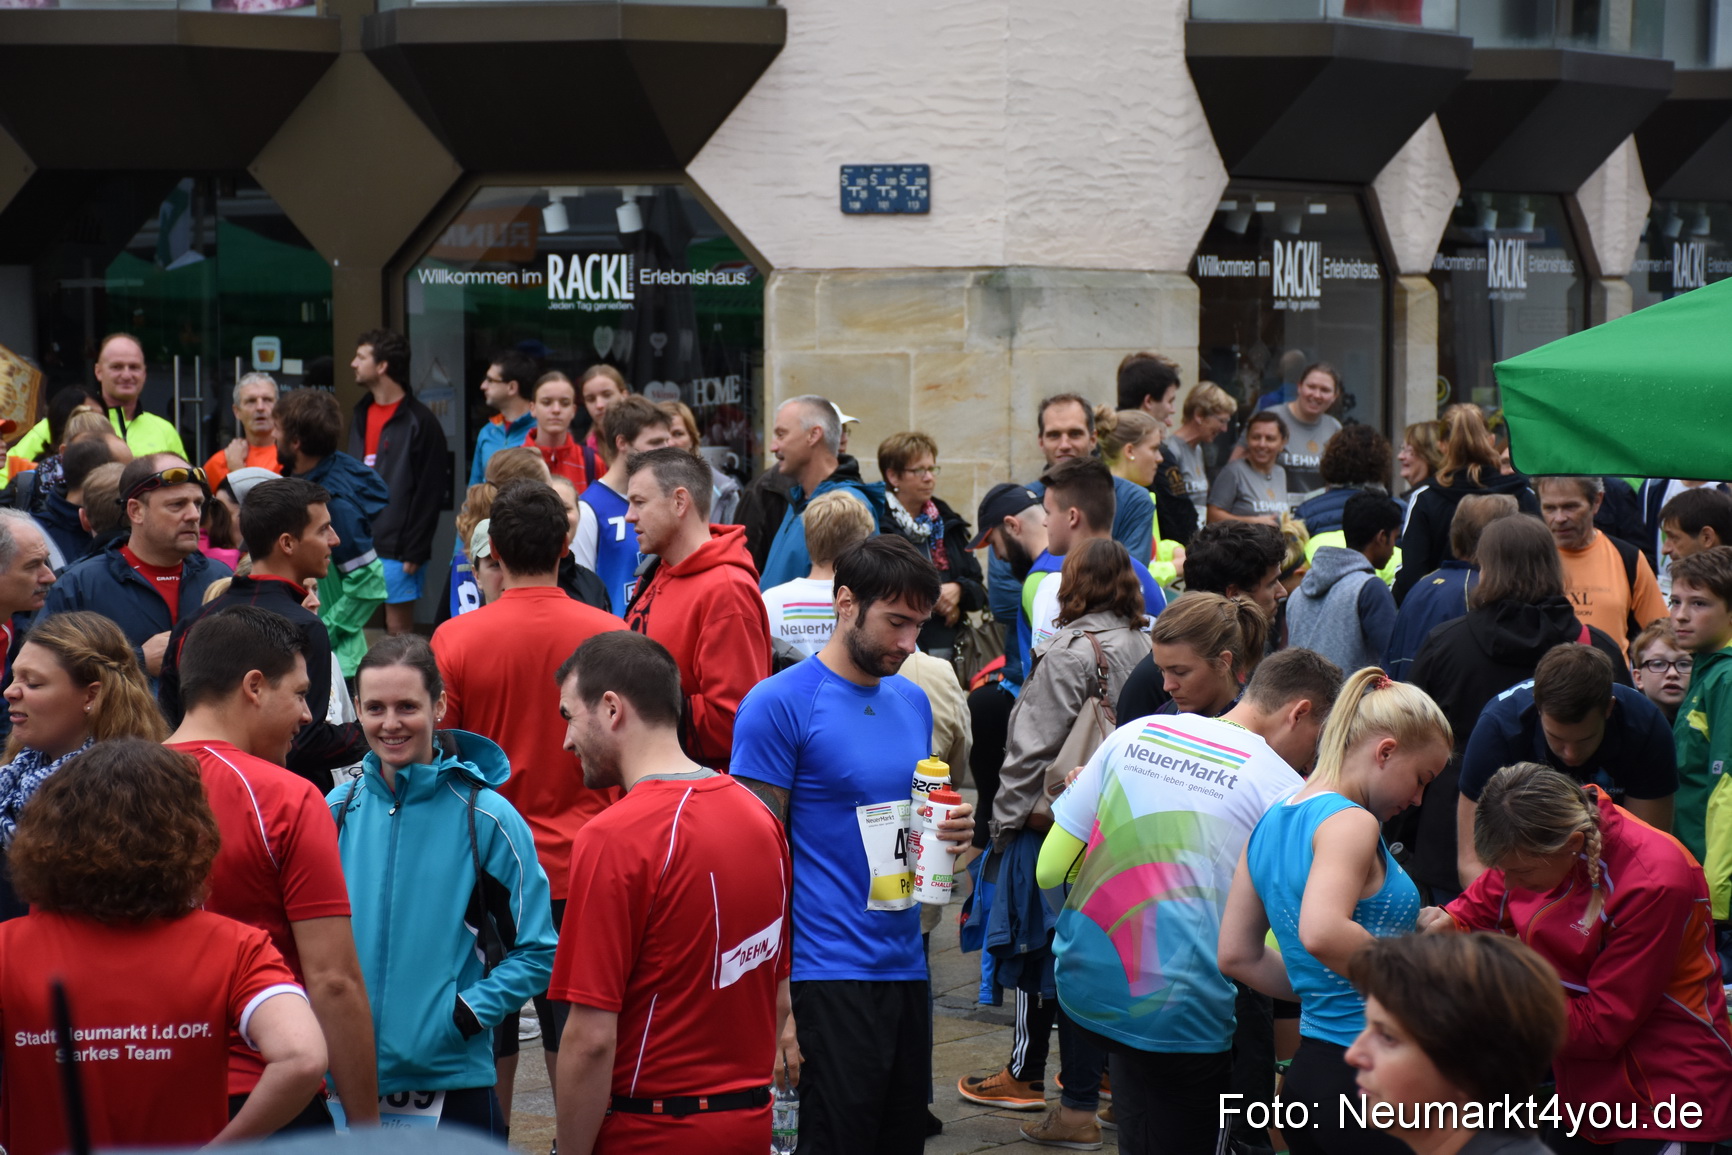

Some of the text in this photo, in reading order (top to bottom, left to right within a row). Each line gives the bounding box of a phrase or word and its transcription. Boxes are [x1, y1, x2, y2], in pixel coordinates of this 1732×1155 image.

[417, 253, 751, 301] Willkommen im RACKL Erlebnishaus.
[1197, 255, 1256, 277] Willkommen
[1258, 255, 1271, 277] im
[1273, 239, 1321, 298] RACKL
[1487, 237, 1527, 289] RACKL
[1673, 241, 1707, 289] RACKL
[548, 301, 575, 311] Jeden
[576, 301, 593, 313] Tag
[692, 374, 741, 407] HOME
[1123, 743, 1239, 790] NeuerMarkt
[1123, 763, 1224, 800] einkaufen leben genießen
[866, 815, 895, 824] NeuerMarkt
[739, 937, 769, 968] DEHN
[14, 1023, 213, 1047] Stadt eumarkt i.d.OPf.
[54, 1044, 172, 1064] Sarkes Team
